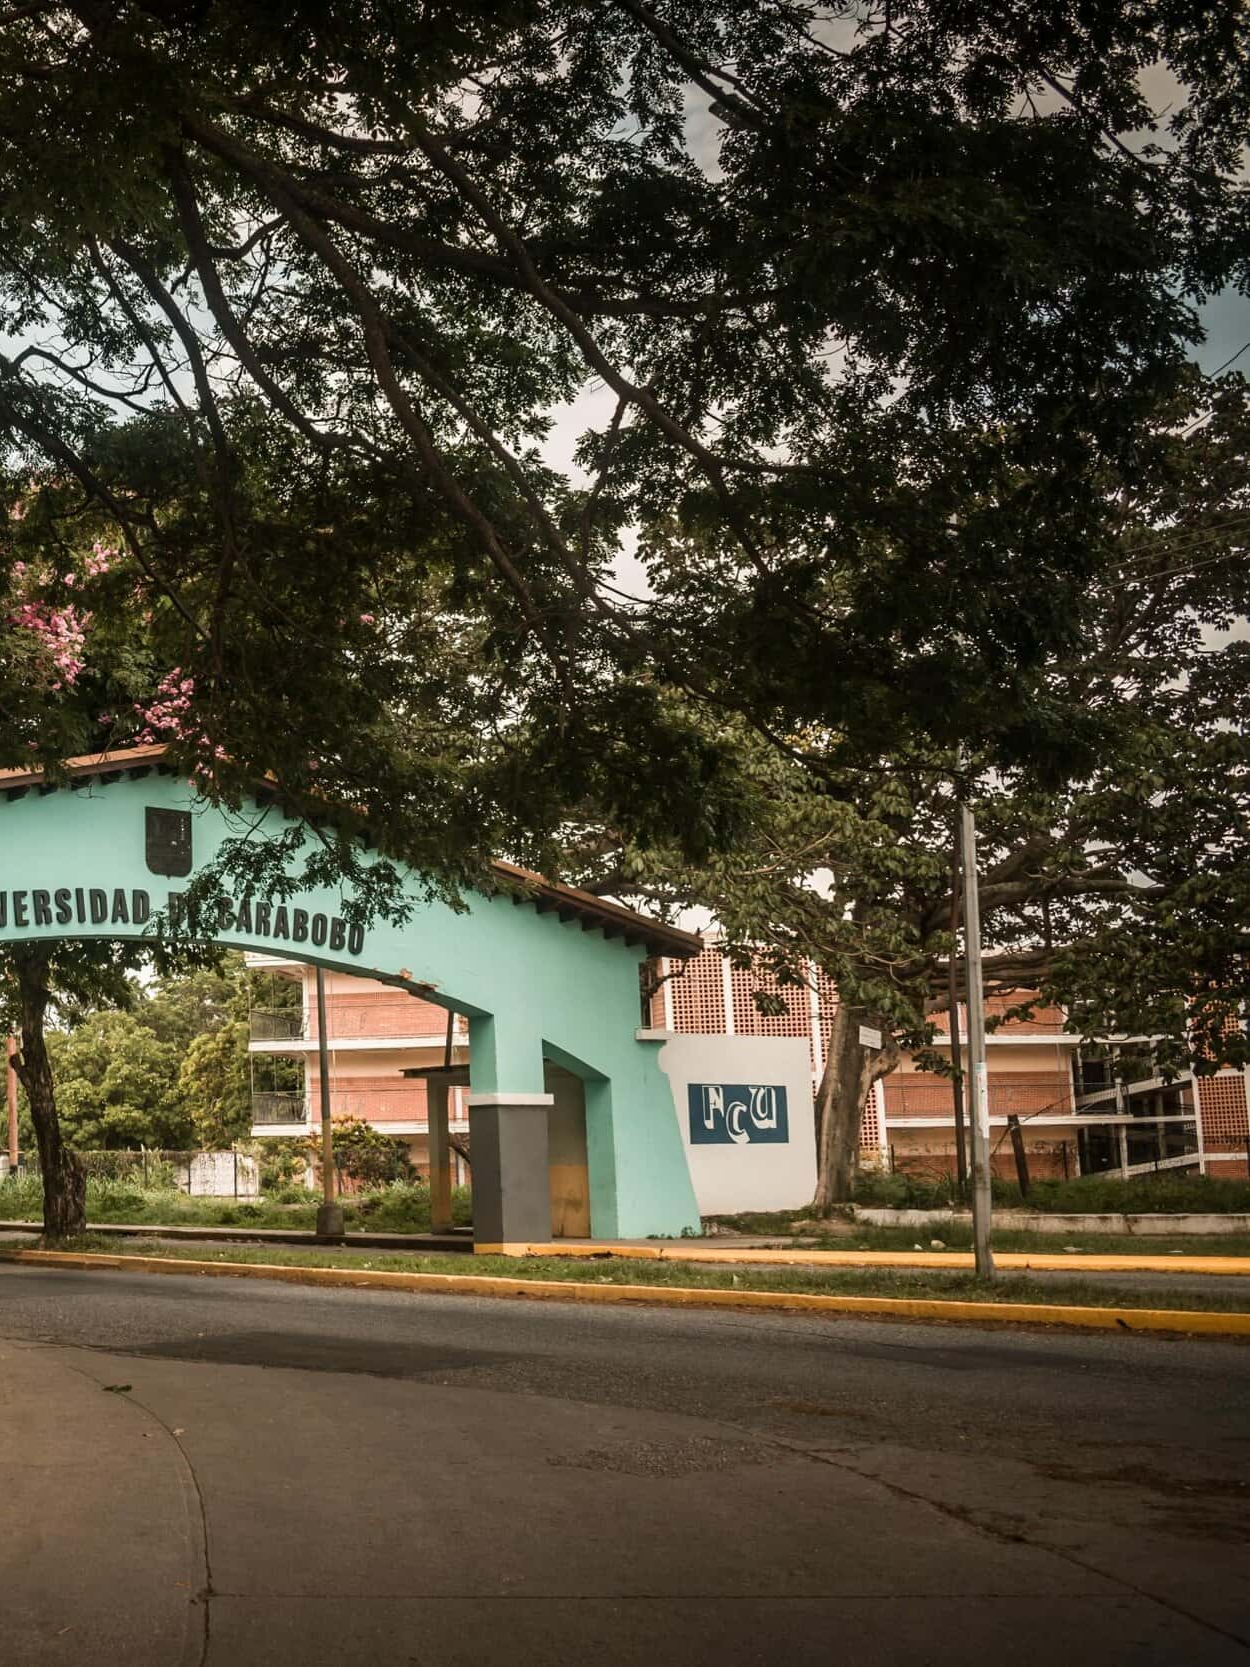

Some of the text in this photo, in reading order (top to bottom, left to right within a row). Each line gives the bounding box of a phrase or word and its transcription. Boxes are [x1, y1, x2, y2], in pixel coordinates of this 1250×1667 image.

[167, 891, 203, 932] D
[216, 895, 366, 956] CARABOBO
[701, 1085, 778, 1144] FCU
